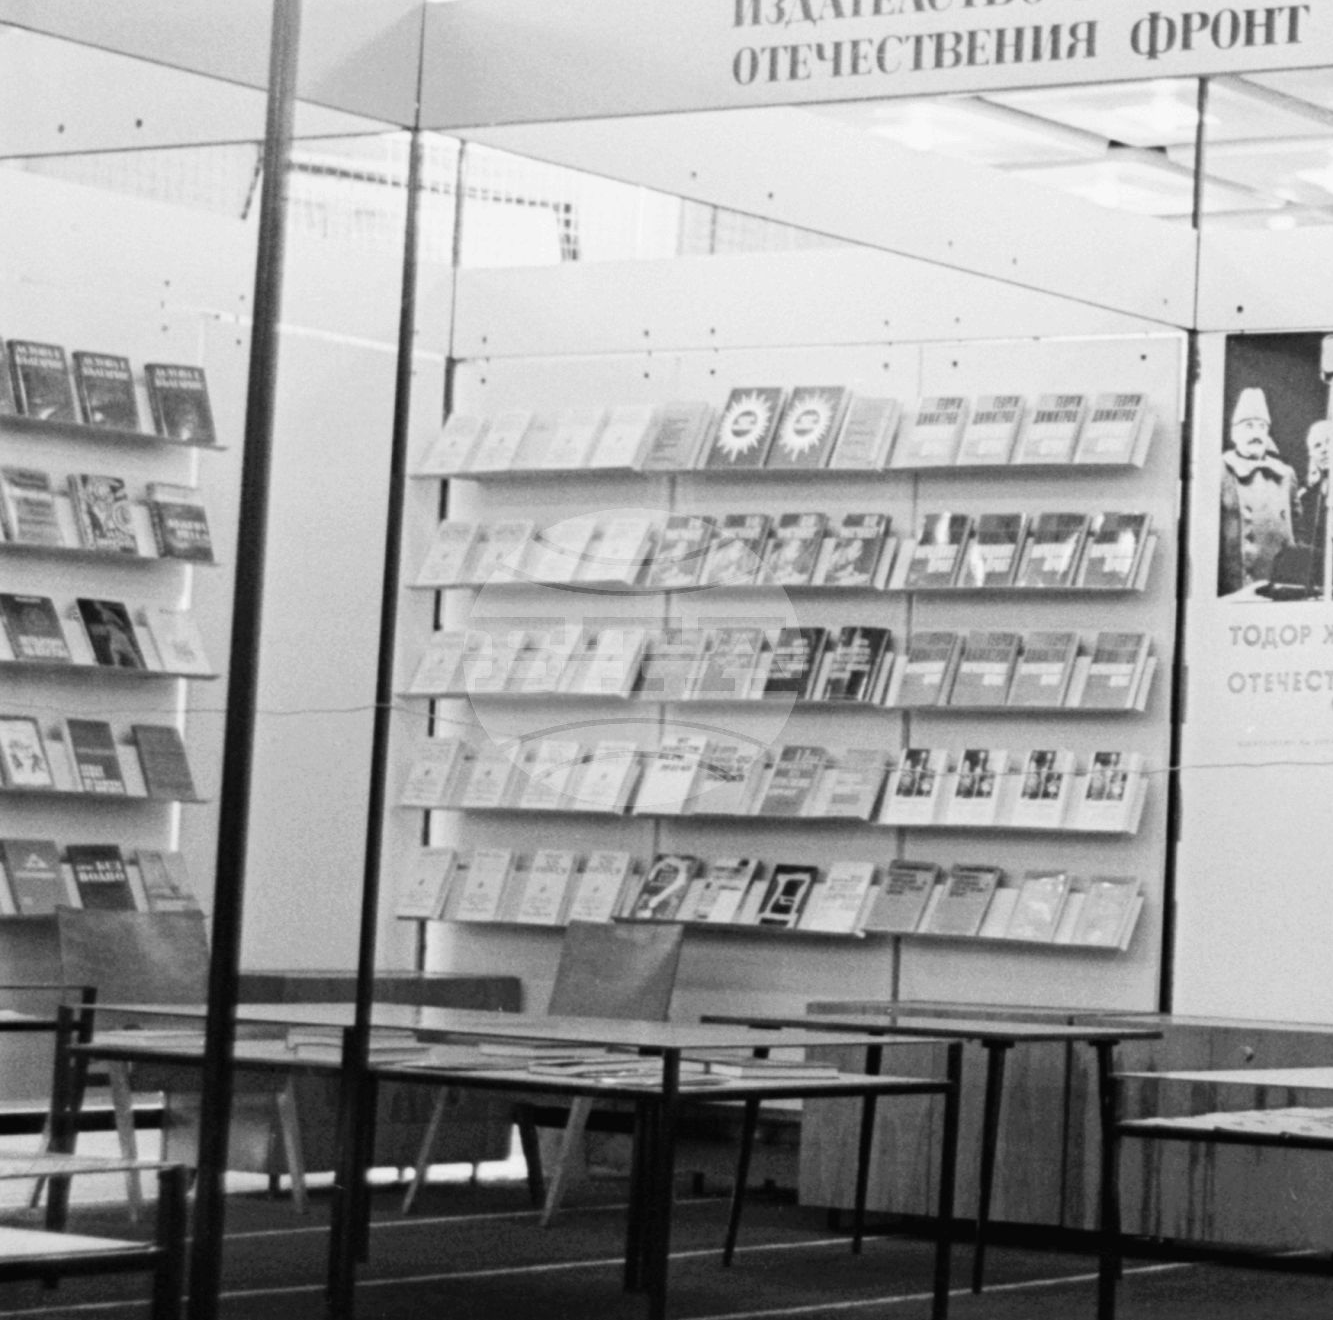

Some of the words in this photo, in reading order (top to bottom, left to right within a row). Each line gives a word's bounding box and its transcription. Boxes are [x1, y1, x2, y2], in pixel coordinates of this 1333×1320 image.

[732, 19, 1099, 86] ОТЕЧЕСТВЕНИЯ
[1129, 4, 1311, 60] ФРОНТ
[1228, 623, 1312, 650] ТОДОР
